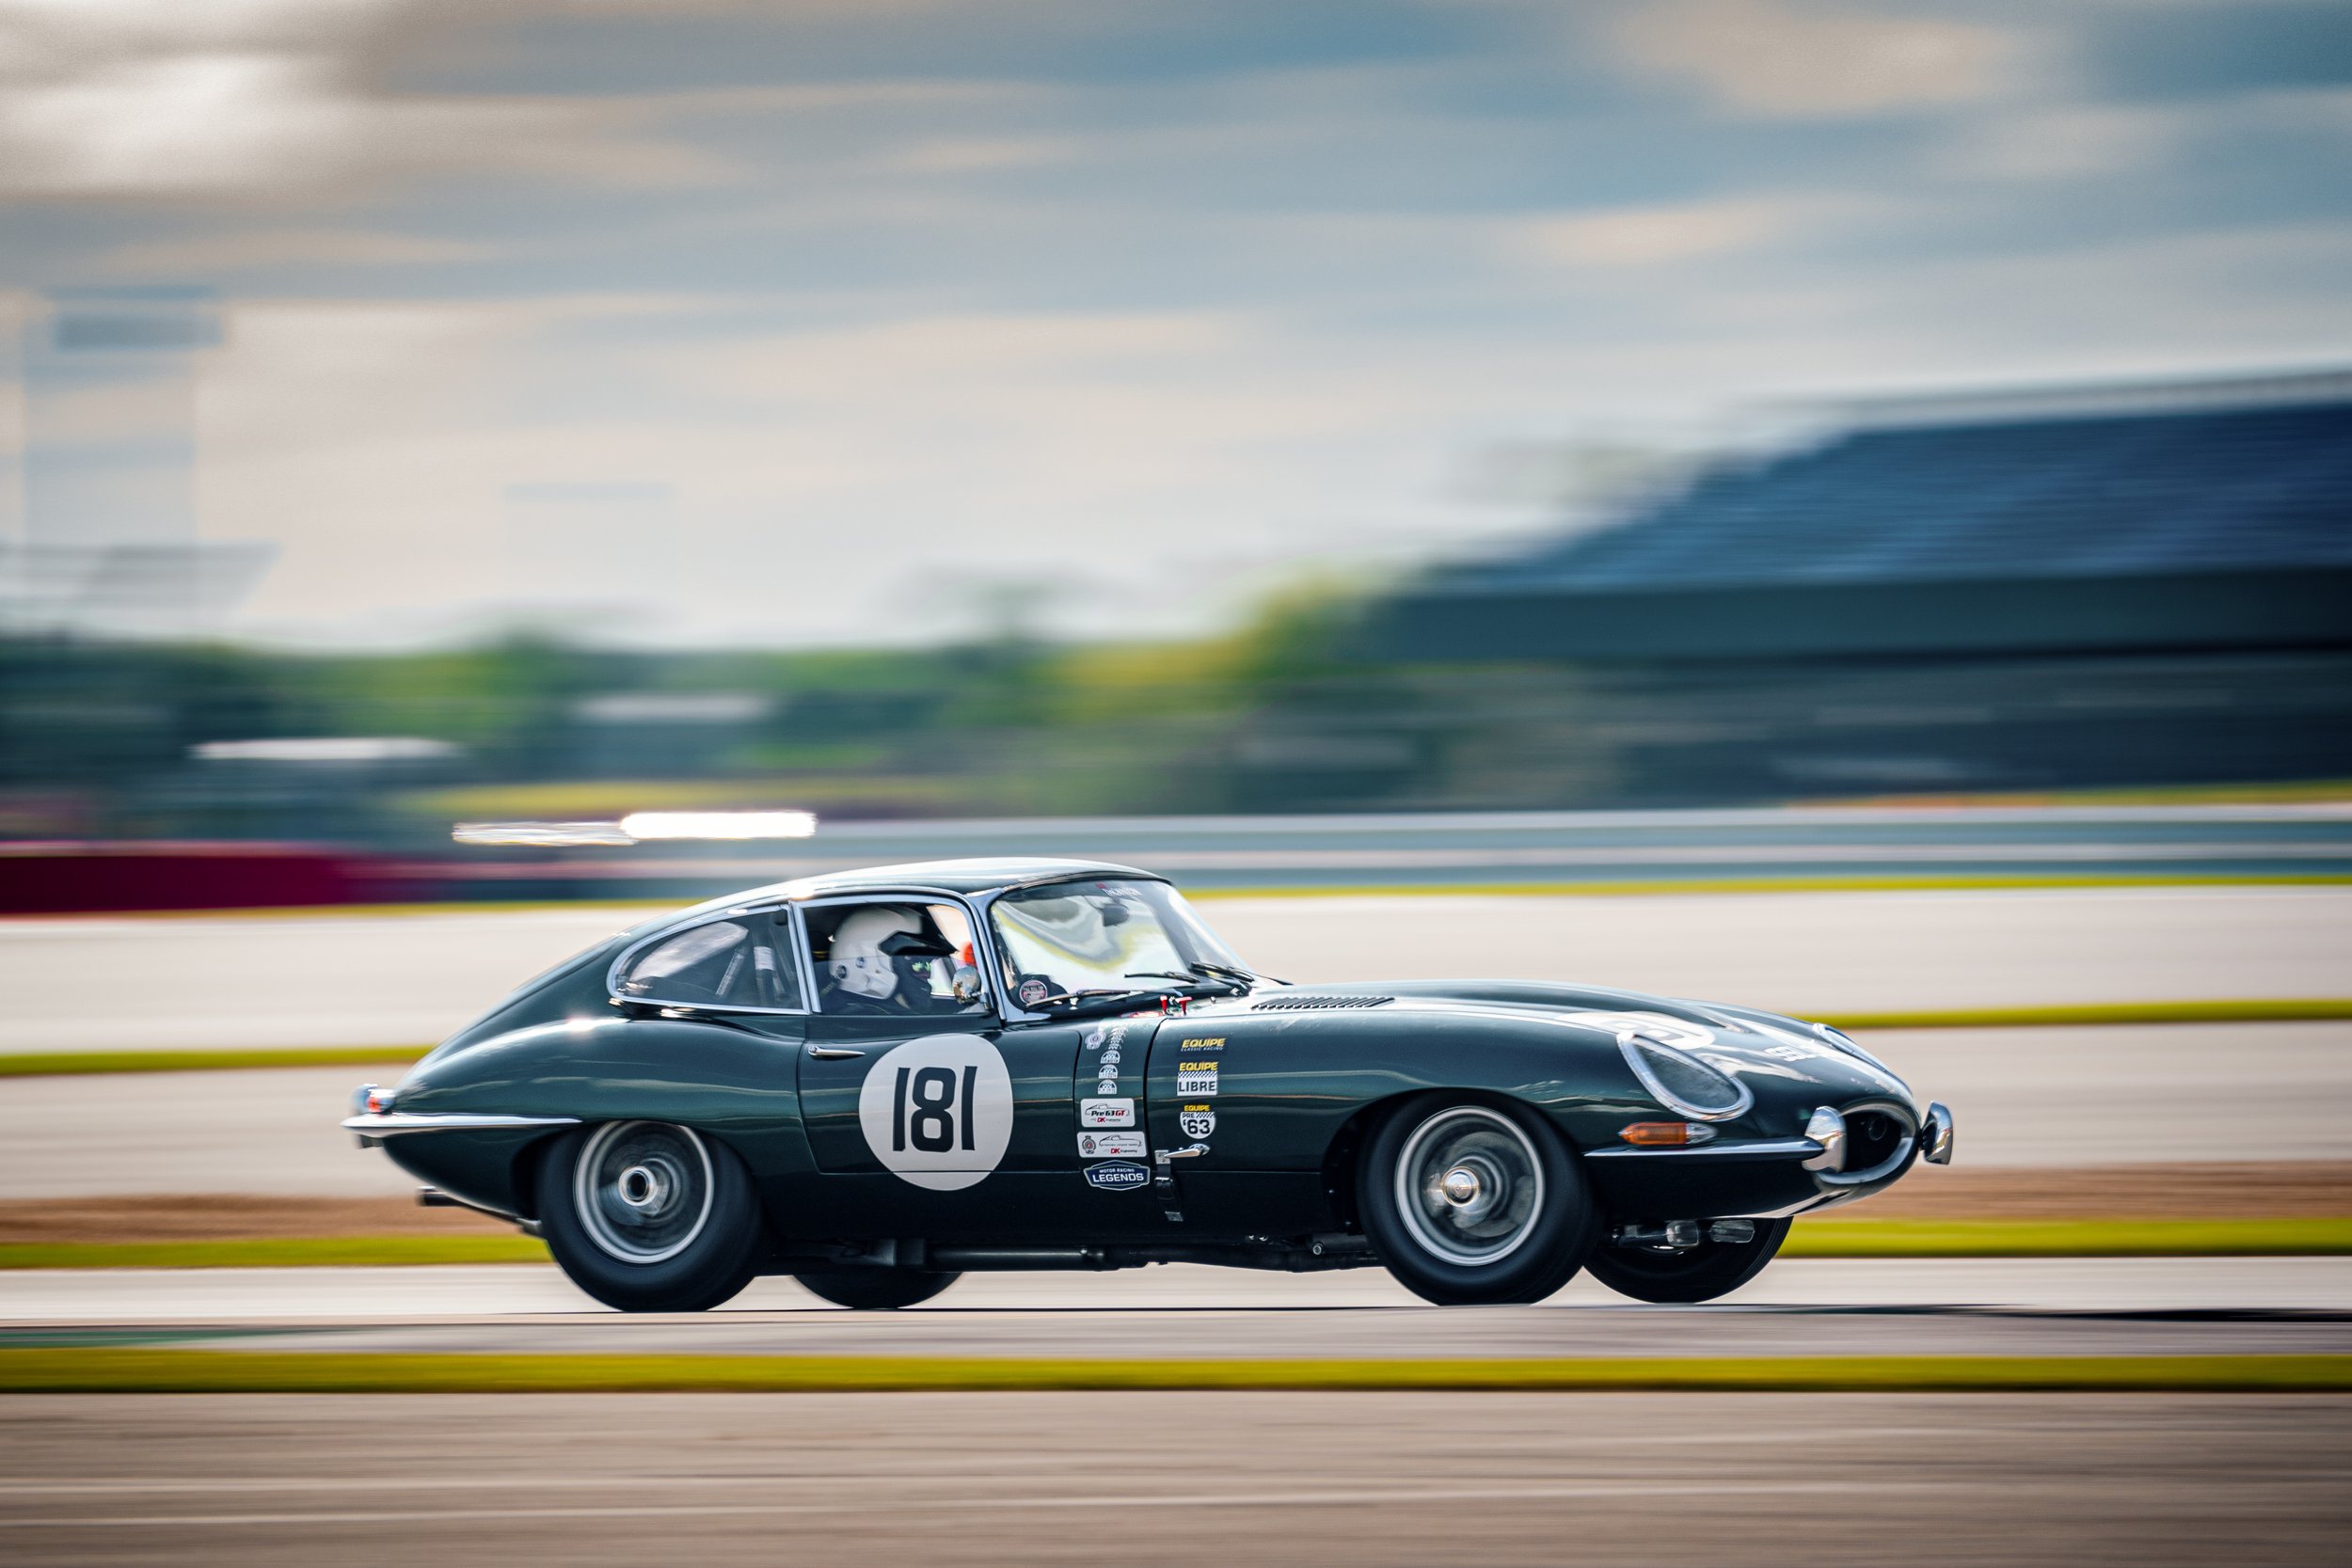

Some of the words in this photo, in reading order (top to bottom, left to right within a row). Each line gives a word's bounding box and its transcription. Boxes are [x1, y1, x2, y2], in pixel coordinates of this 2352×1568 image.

[1182, 1038, 1226, 1048] EQUIPE
[1179, 1062, 1218, 1071] EQUIPE
[1178, 1082, 1216, 1092] LIBRE
[893, 1066, 977, 1152] 181
[1092, 1173, 1145, 1182] LEGENDS
